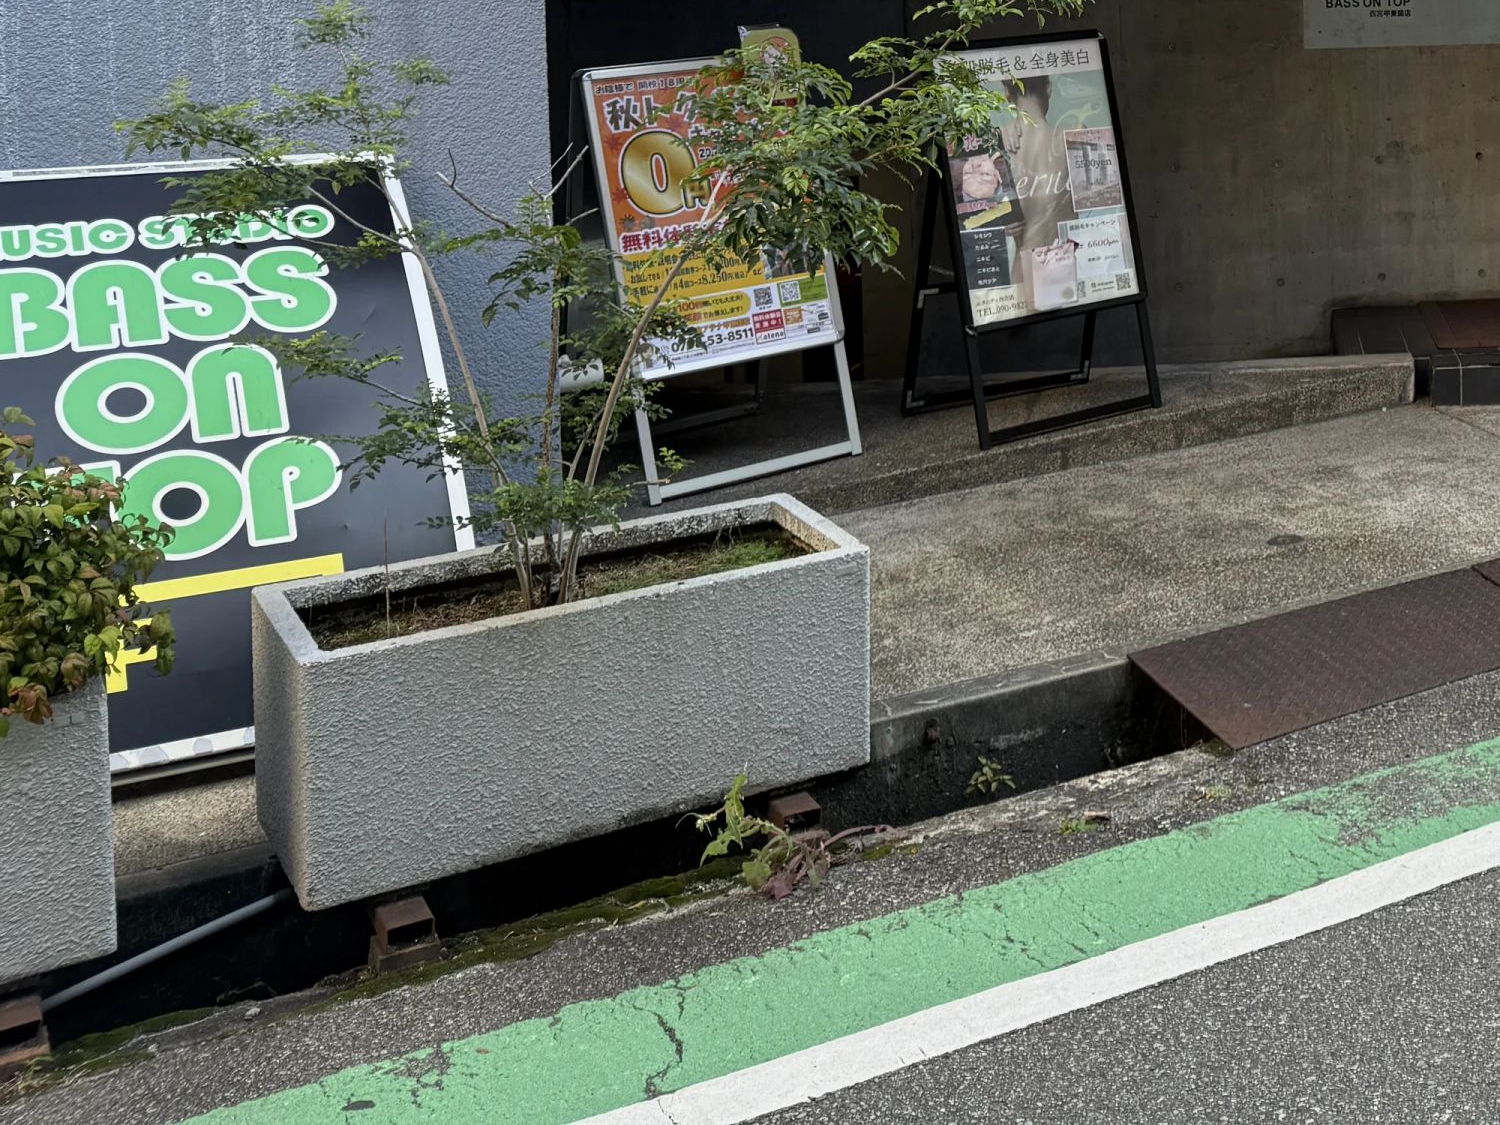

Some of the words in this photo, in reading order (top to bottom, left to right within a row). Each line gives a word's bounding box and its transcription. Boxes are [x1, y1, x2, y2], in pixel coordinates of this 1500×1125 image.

[1014, 55, 1027, 71] &
[1030, 48, 1090, 70] 全身美白
[0, 246, 337, 360] BASS
